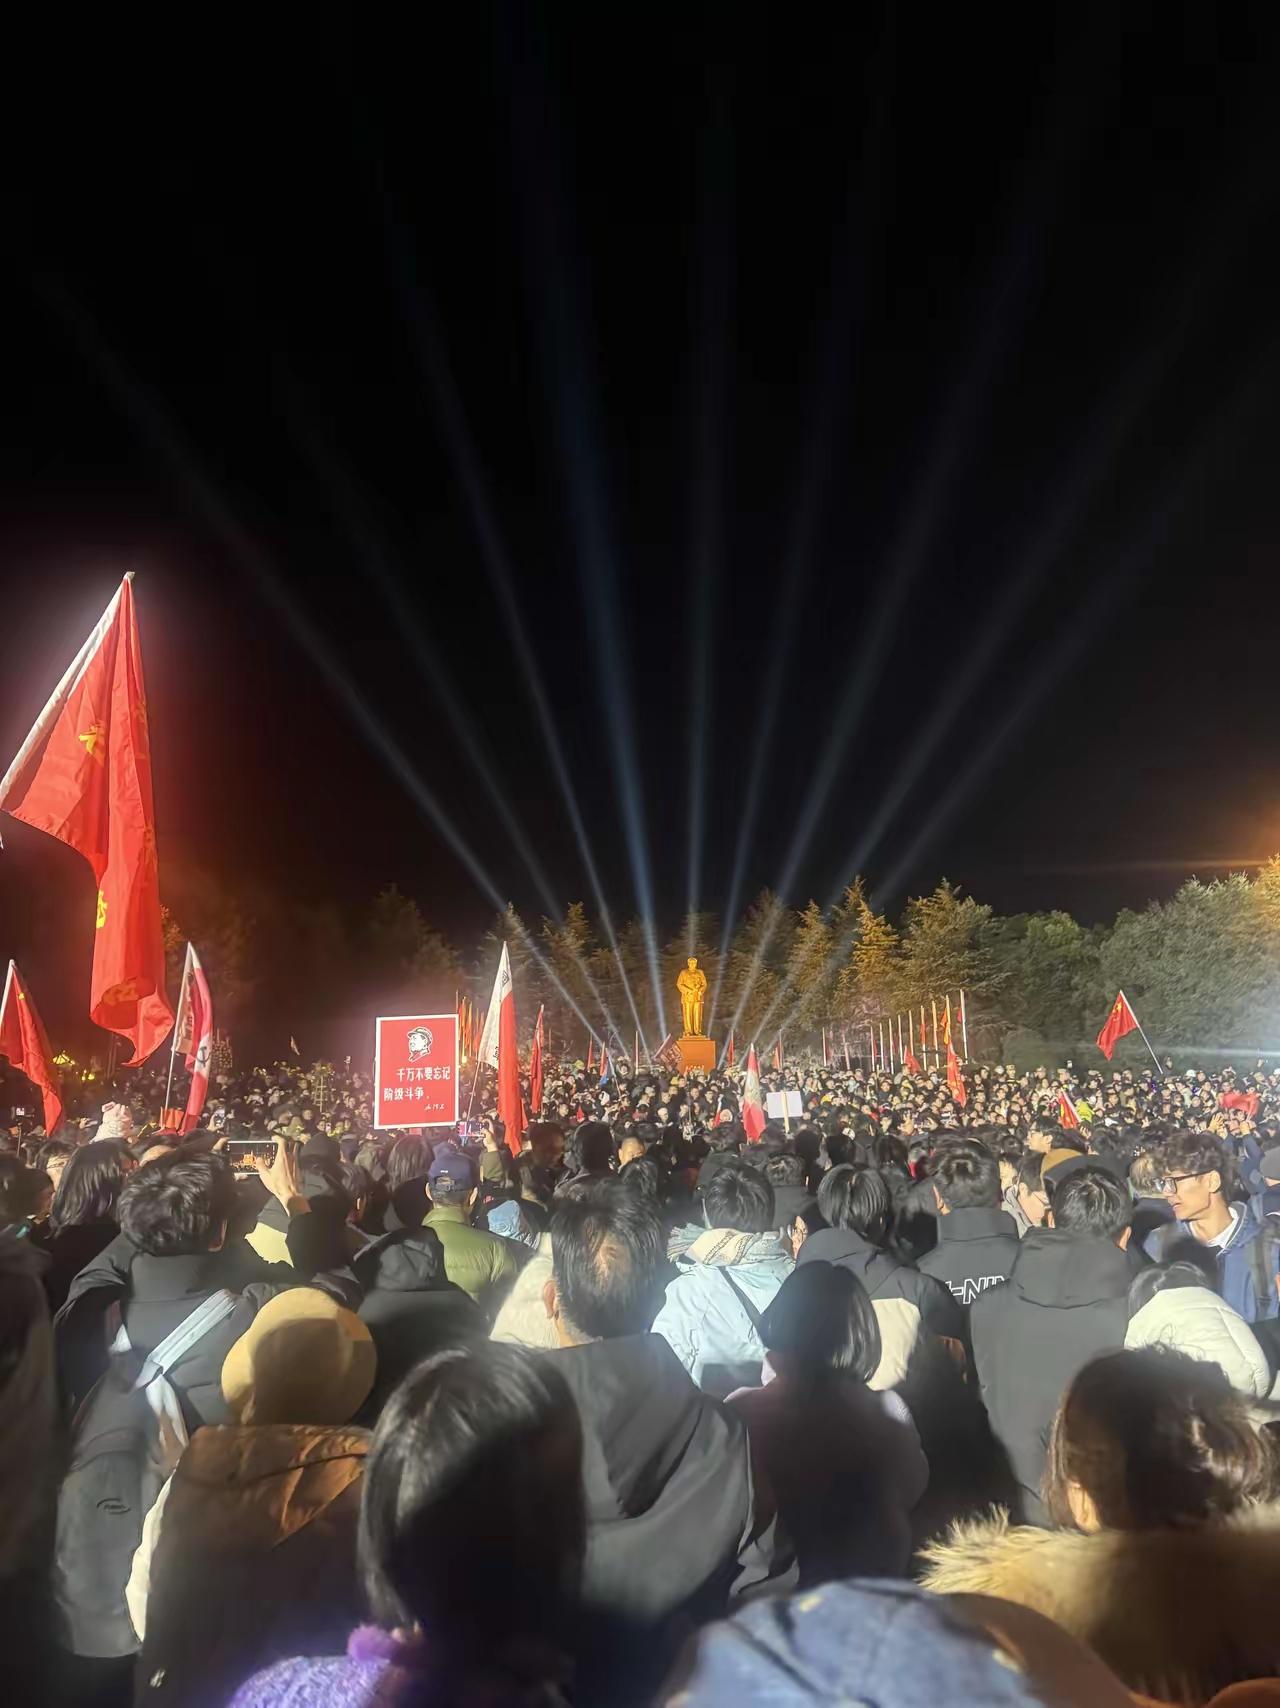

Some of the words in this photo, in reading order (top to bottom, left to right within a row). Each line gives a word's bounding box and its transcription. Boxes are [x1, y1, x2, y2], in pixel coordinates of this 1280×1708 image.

[396, 1066, 450, 1082] 千万不要忘记
